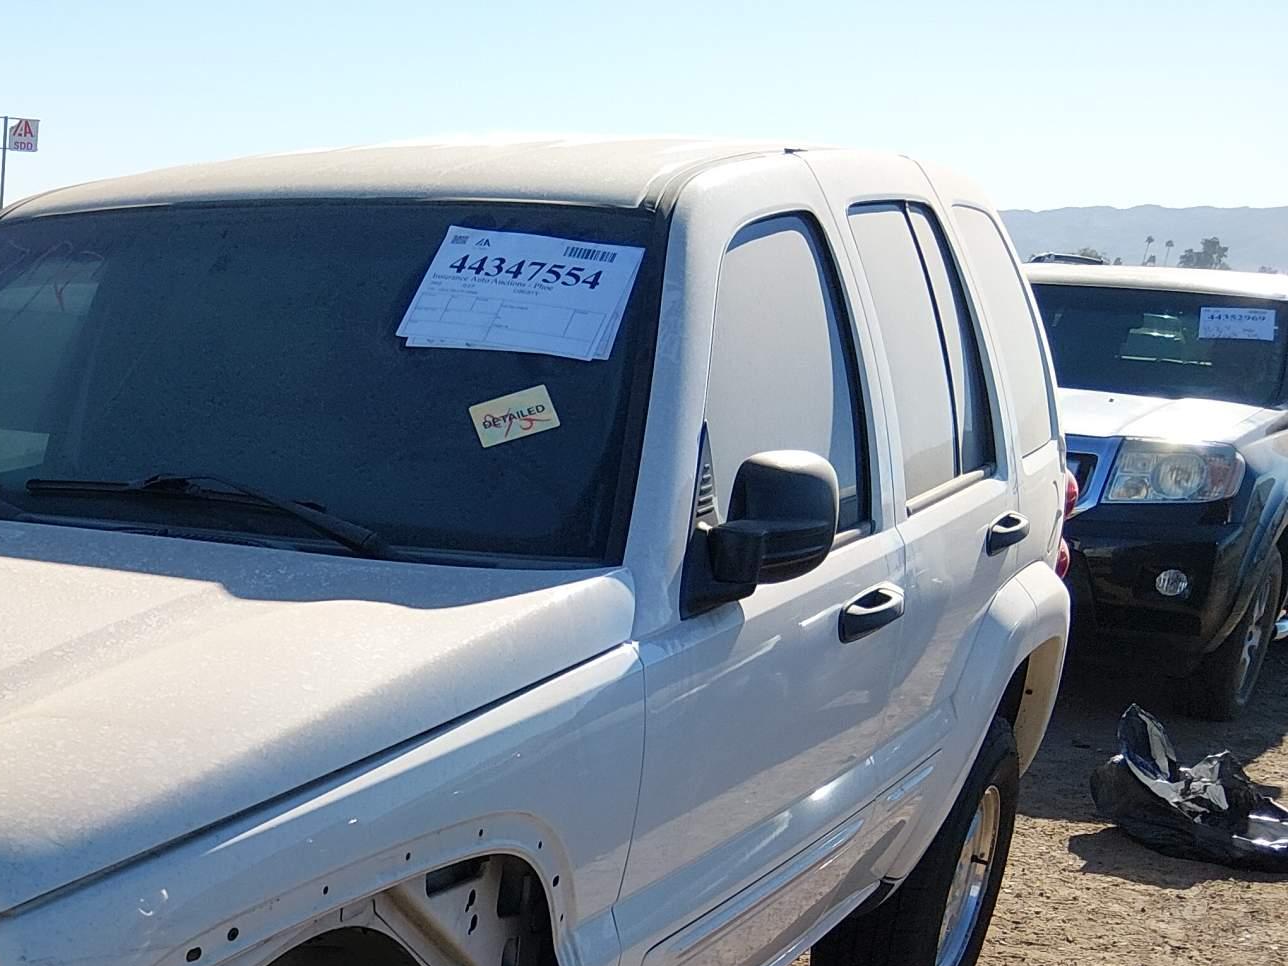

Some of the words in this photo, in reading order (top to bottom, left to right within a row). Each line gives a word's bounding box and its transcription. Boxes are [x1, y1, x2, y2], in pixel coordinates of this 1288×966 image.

[449, 254, 603, 290] 44347554
[471, 276, 490, 284] Auto
[491, 278, 527, 288] Auctions
[482, 404, 546, 430] DETAILED
